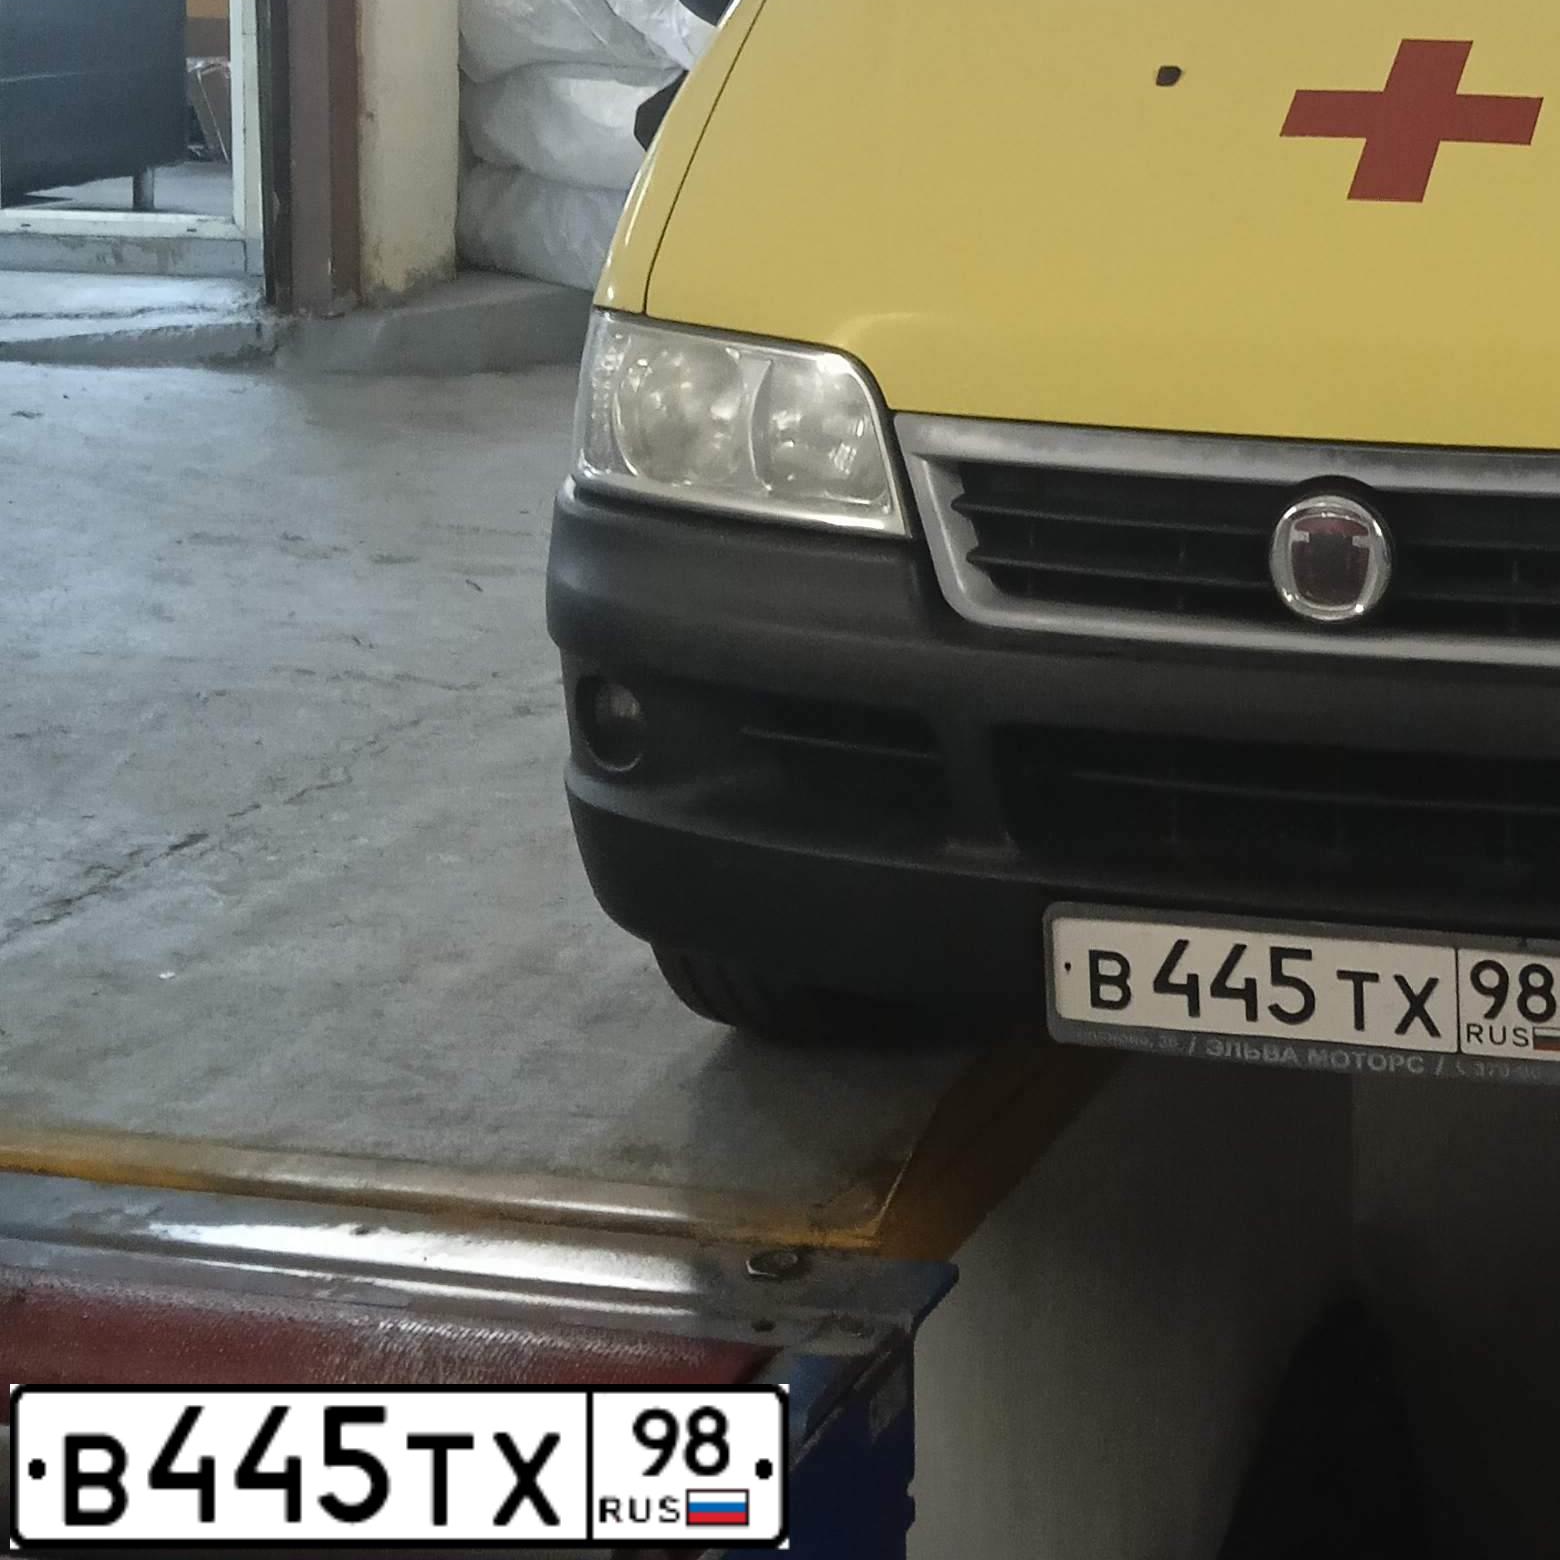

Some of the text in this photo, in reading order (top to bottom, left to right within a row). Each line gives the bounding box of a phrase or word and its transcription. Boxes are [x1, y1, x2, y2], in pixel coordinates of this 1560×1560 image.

[1469, 959, 1557, 1023] 98
[1465, 1023, 1530, 1048] RUS
[1205, 1039, 1302, 1066] ЭЛЬВА
[1307, 1049, 1425, 1075] МОТОРС
